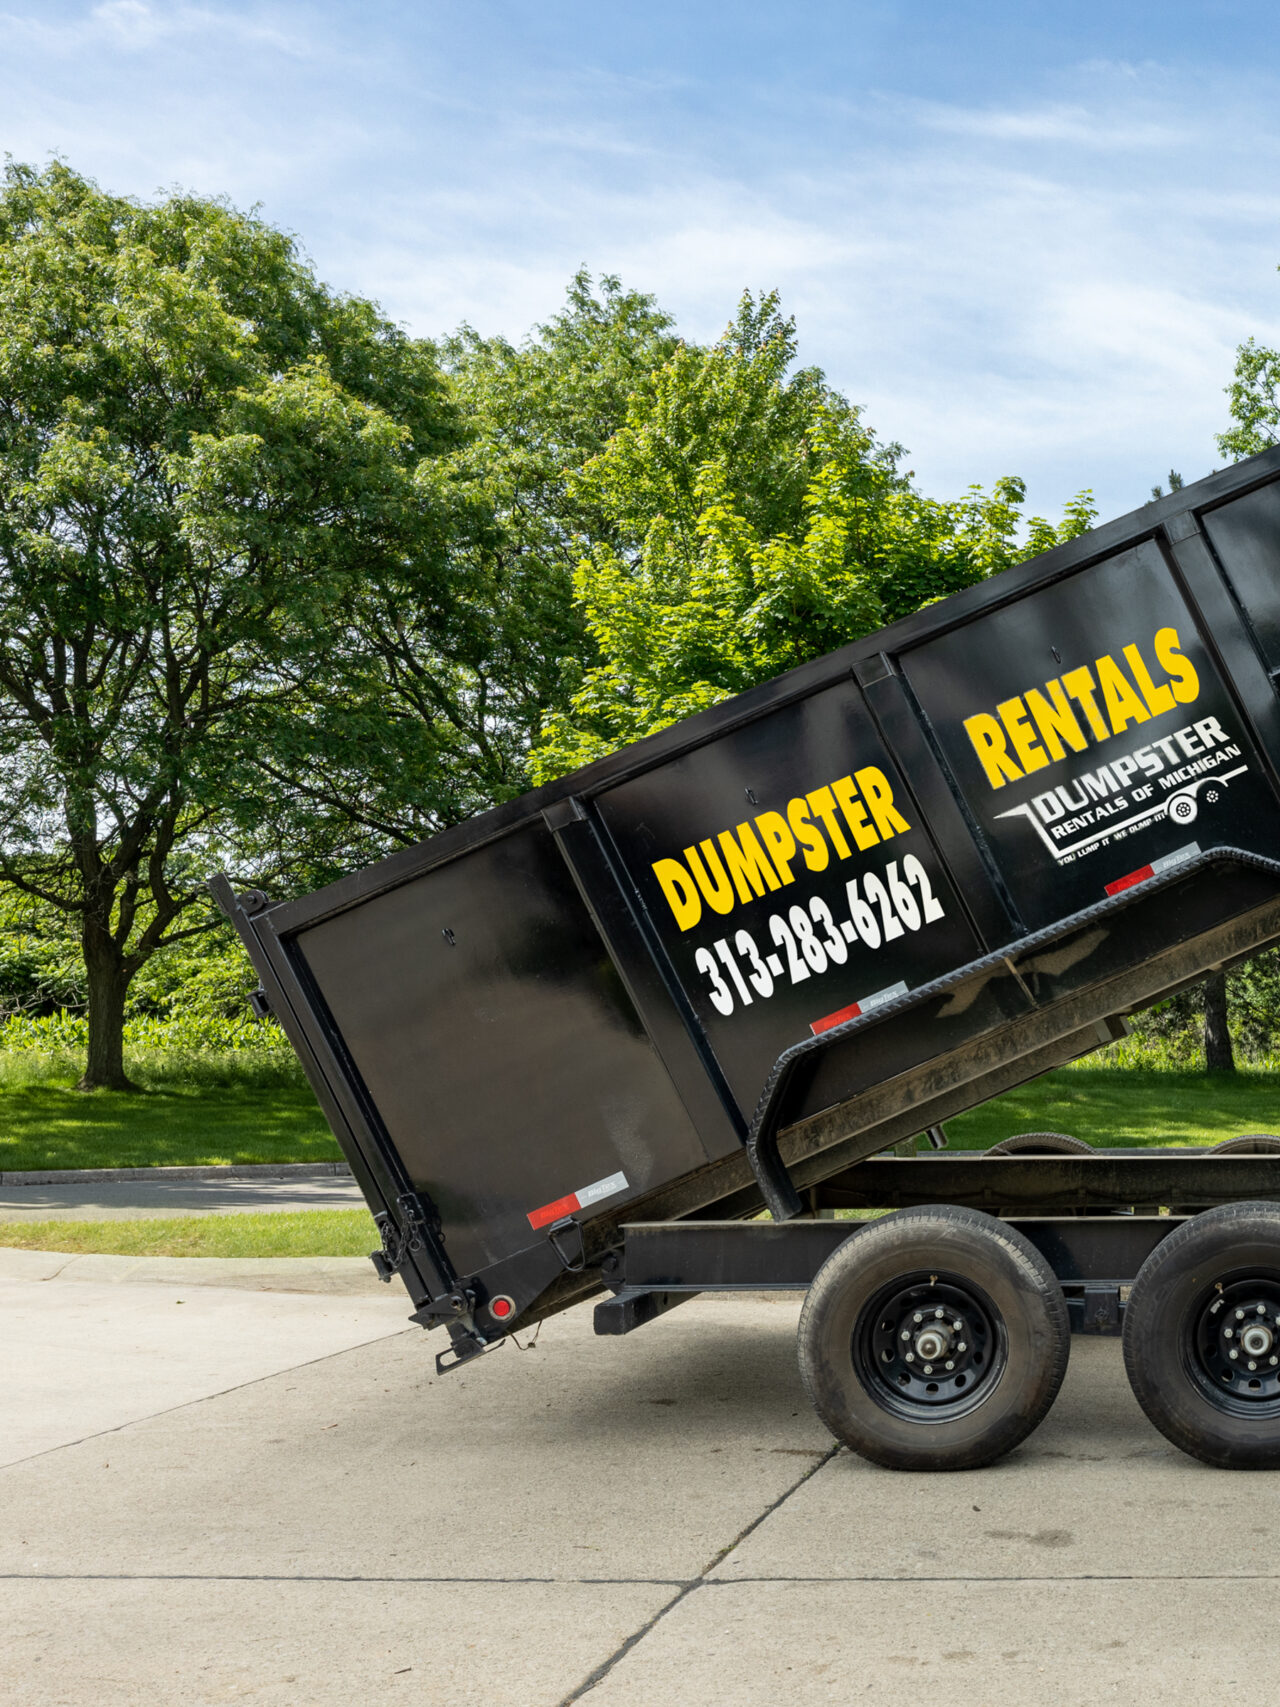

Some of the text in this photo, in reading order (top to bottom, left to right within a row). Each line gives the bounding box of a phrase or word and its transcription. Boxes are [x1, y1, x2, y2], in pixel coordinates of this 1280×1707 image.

[964, 627, 1199, 790] RENTALS
[1031, 716, 1230, 824] DUMPSTER
[652, 766, 911, 932] DUMPSTER
[1051, 744, 1241, 839] RENTALS OF MICHIGAN
[1057, 853, 1076, 866] YOU
[1077, 842, 1100, 858] LUMP
[1113, 830, 1128, 840] WE
[1129, 818, 1152, 833] DUMP
[695, 854, 945, 1016] 313-283-6262
